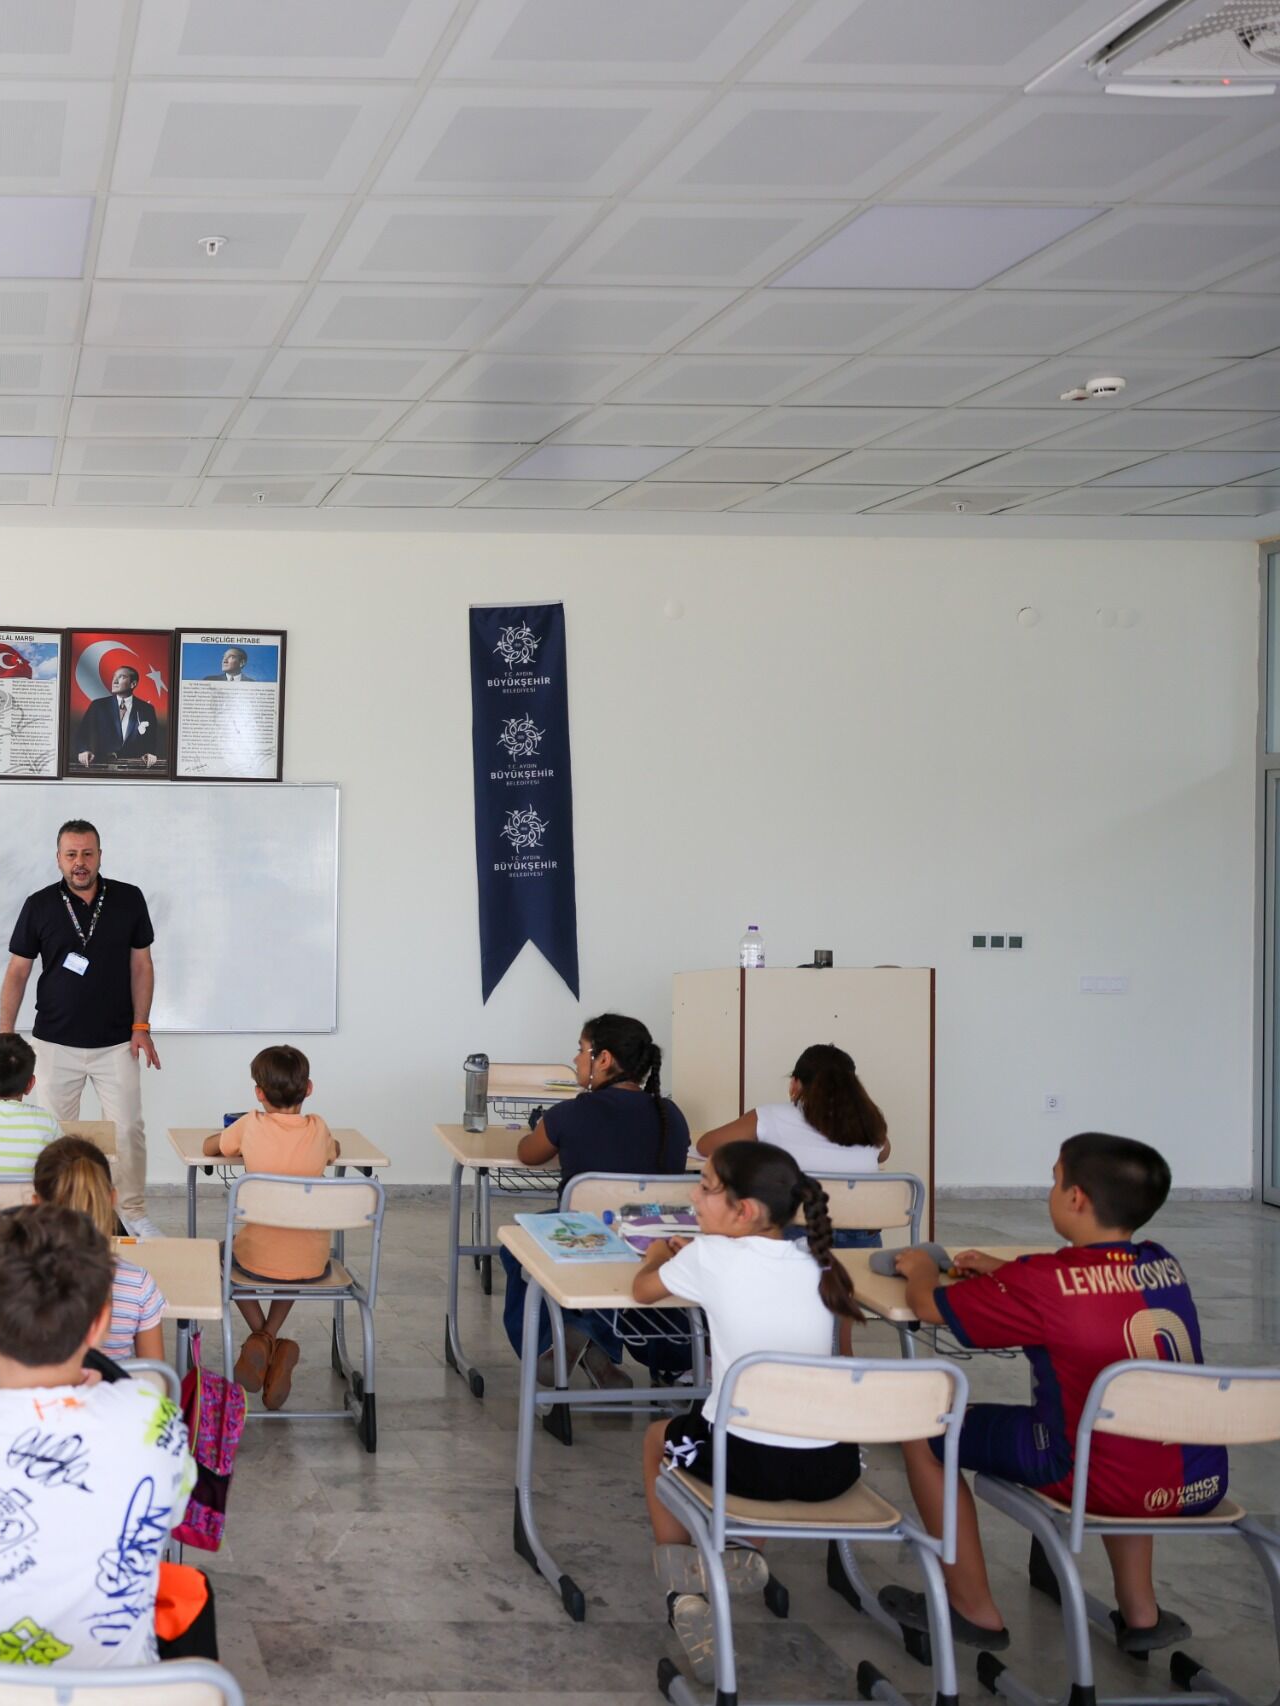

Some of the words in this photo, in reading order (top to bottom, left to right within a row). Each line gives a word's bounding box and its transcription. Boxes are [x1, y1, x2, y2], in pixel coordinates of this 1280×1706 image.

[487, 676, 551, 687] BÜYÜKŞEHİR
[490, 768, 554, 779] BÜYÜKŞEHİR
[494, 861, 558, 871] BÜYÜKŞEHİR
[1055, 1258, 1185, 1296] LEWANDOWS
